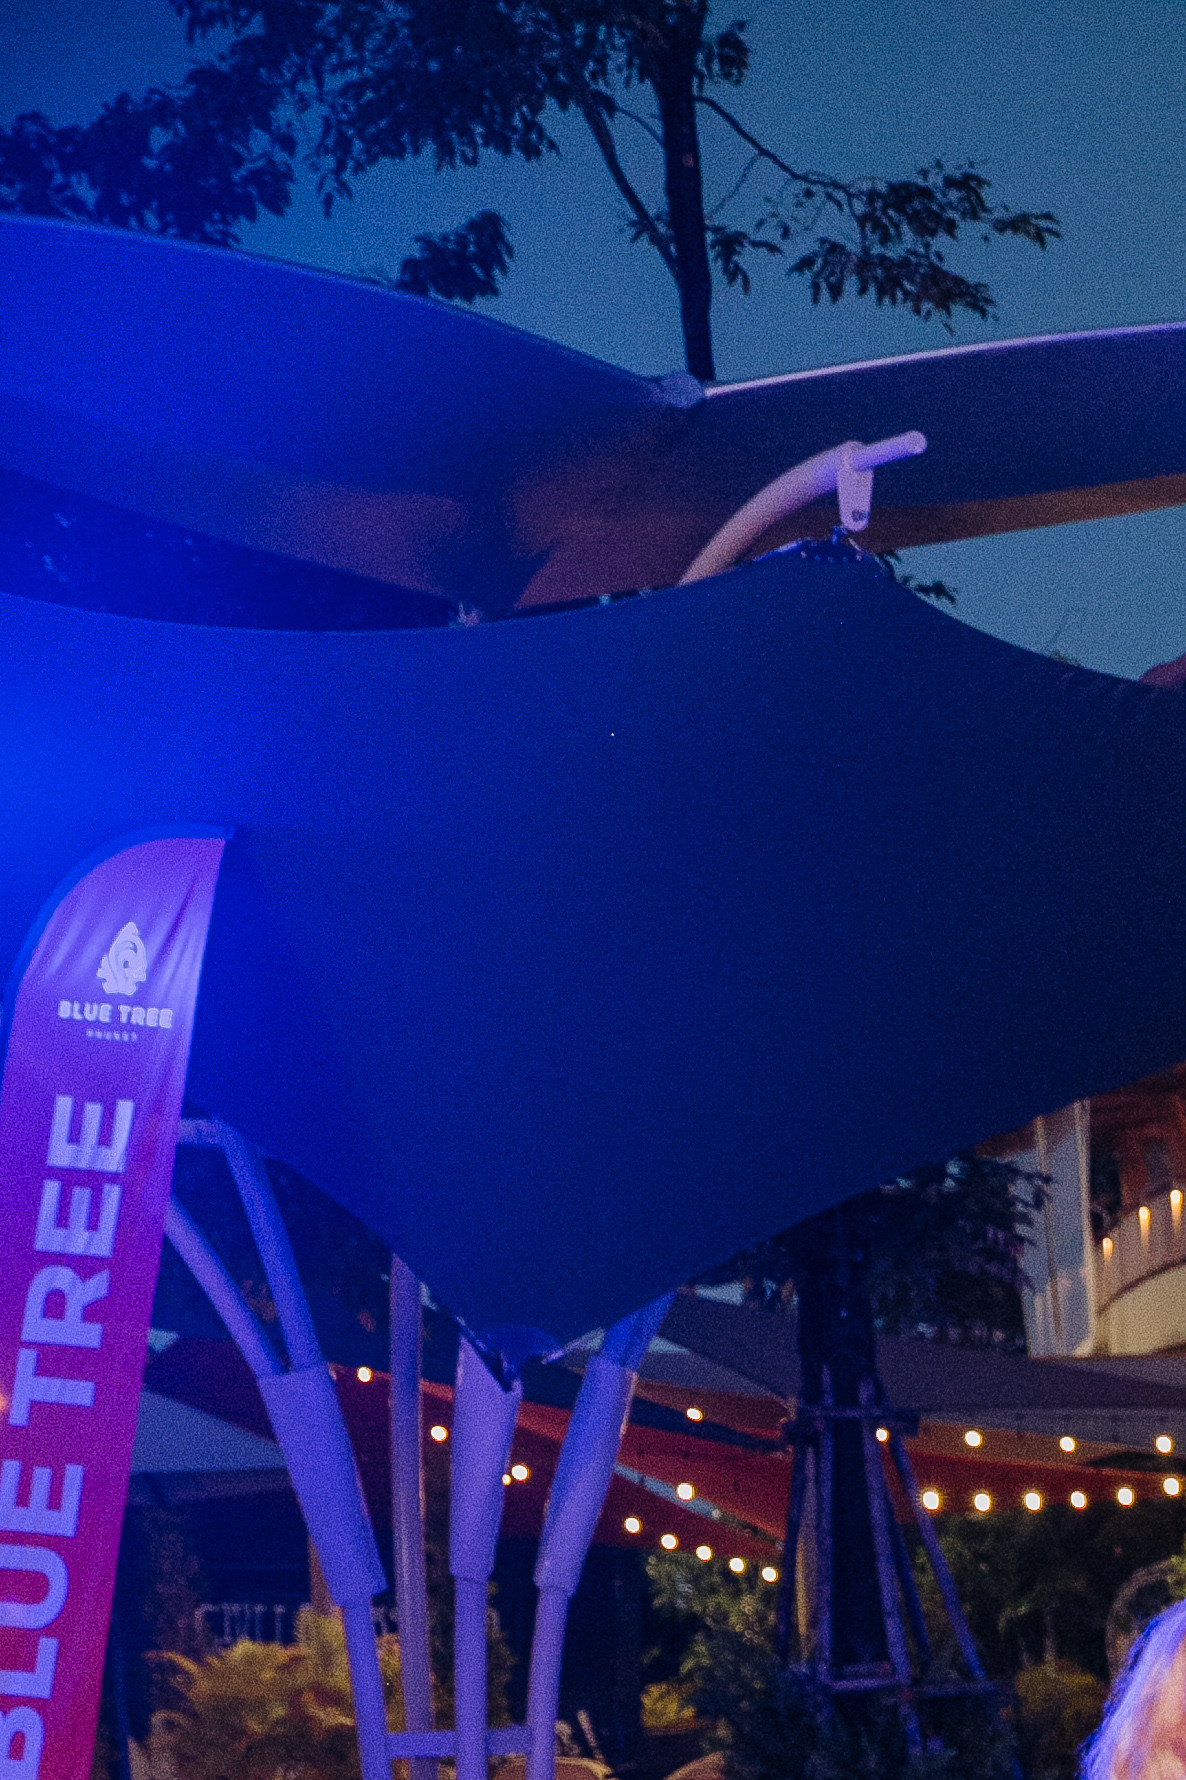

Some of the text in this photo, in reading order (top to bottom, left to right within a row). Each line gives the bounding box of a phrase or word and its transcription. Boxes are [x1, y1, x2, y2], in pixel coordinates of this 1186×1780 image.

[58, 1000, 173, 1028] BLUE TREE
[9, 1095, 135, 1427] TREE
